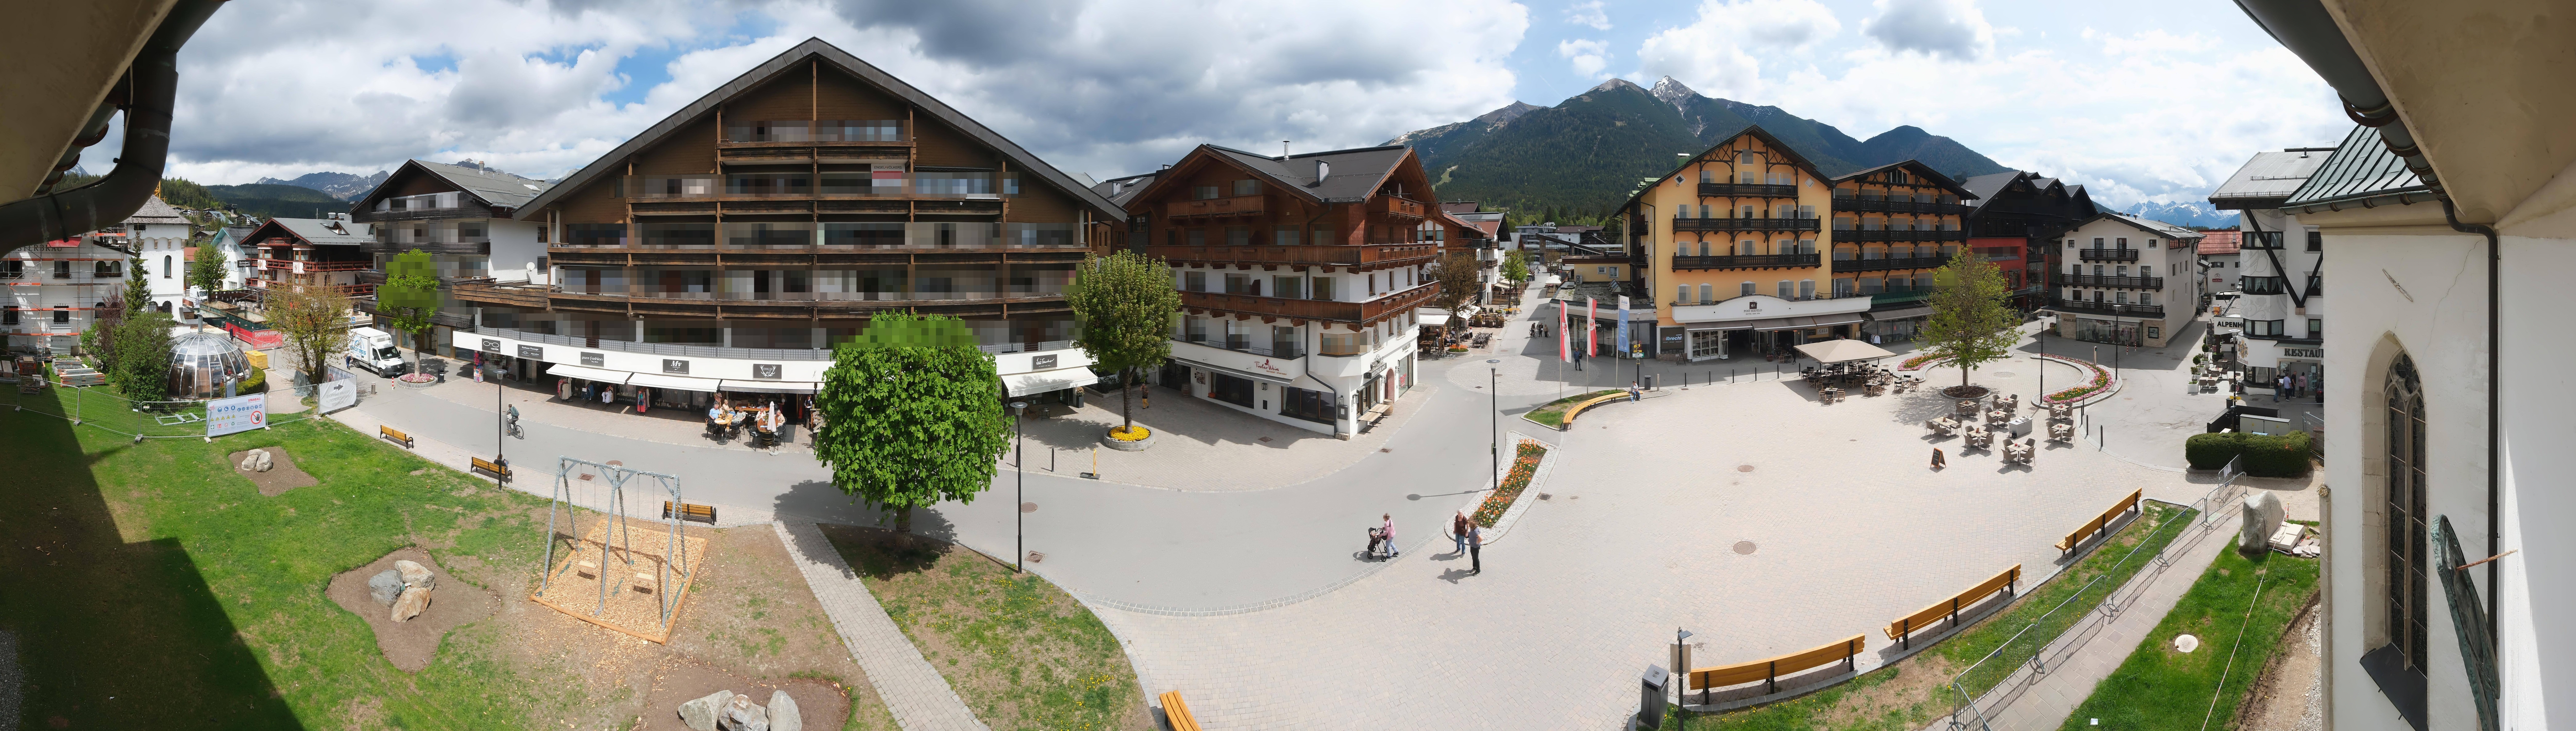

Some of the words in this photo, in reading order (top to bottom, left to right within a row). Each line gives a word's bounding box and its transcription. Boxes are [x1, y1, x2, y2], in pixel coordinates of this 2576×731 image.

[671, 361, 682, 370] My
[1372, 364, 1386, 377] RESTAURANT
[326, 394, 350, 403] KONGRESSZENTRUM
